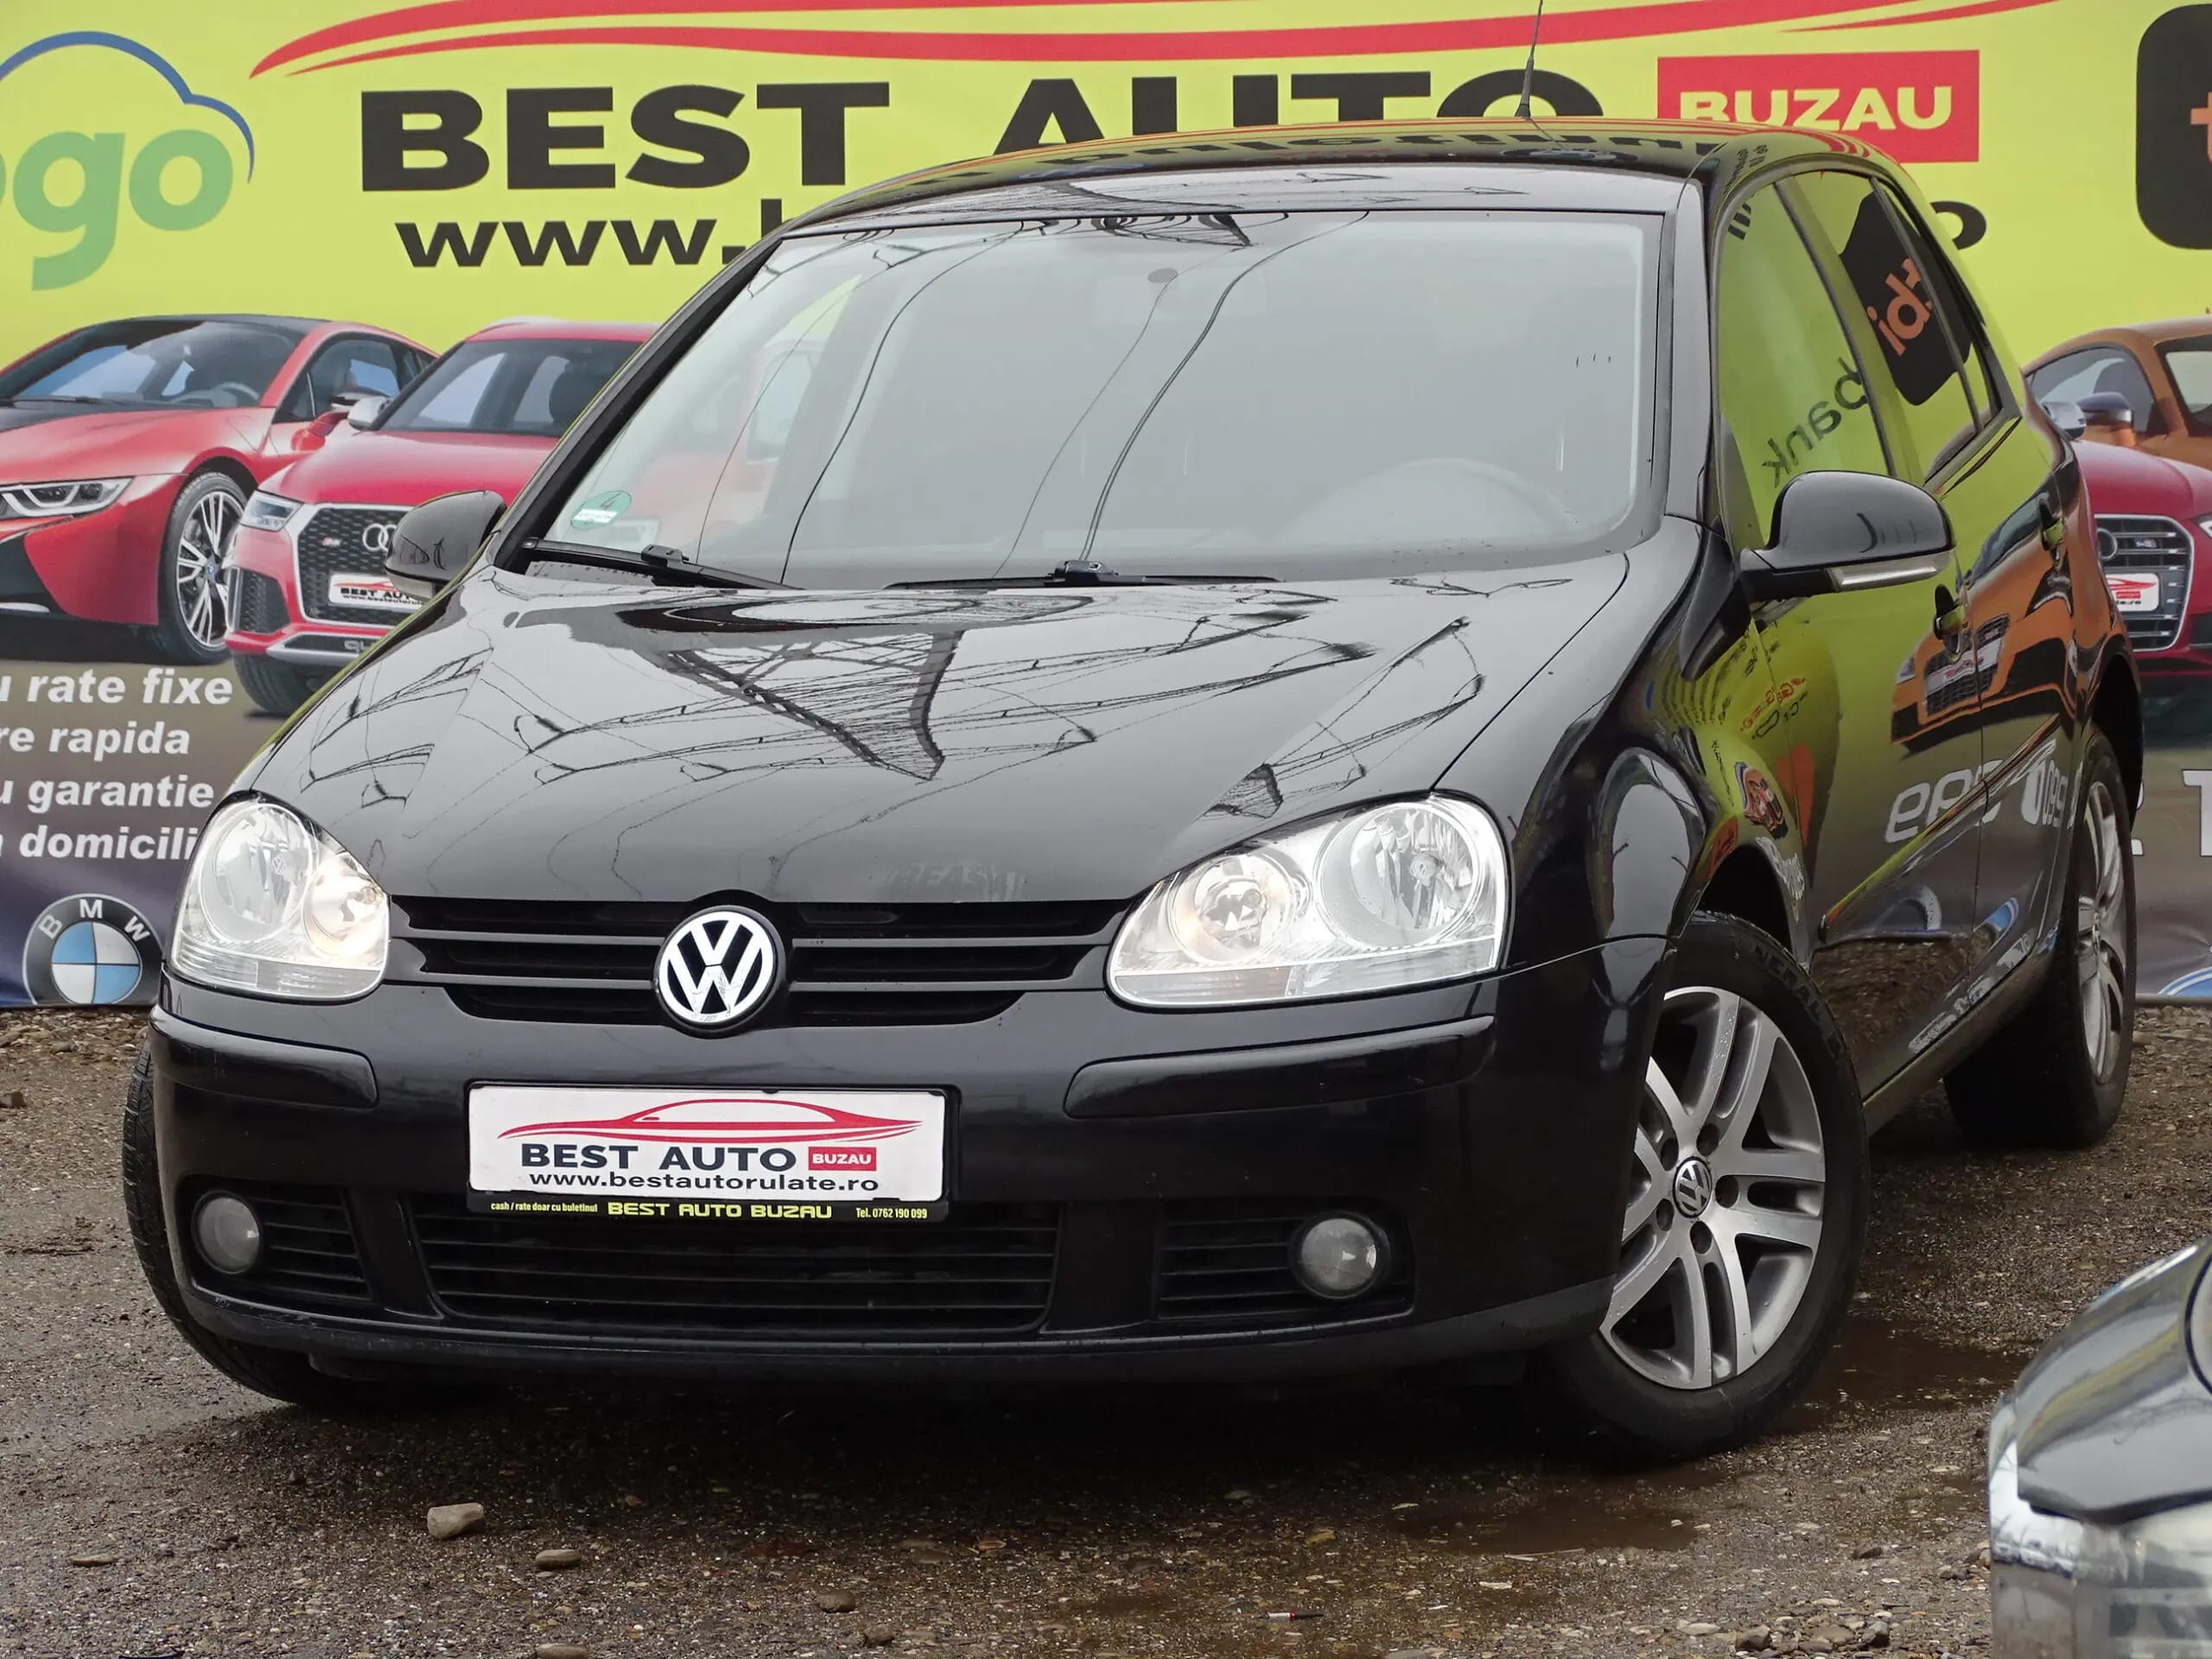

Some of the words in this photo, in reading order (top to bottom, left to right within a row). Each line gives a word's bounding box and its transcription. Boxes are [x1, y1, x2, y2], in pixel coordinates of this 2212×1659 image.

[1681, 86, 1952, 130] BUZAU
[362, 83, 890, 192] BEST
[0, 130, 233, 290] go
[28, 669, 125, 703] rate
[143, 667, 232, 704] fixe
[49, 721, 190, 762] rapida
[27, 774, 214, 814] garantie
[521, 1143, 639, 1169] BEST
[658, 1147, 797, 1172] AUTO
[812, 1154, 872, 1165] BUZAU
[530, 1172, 879, 1192] www.bestautorulate.ro
[491, 1202, 510, 1211] cash
[515, 1202, 531, 1211] rate
[532, 1202, 550, 1211] doar
[562, 1203, 598, 1212] buletinul
[607, 1202, 671, 1216] BEST
[678, 1204, 742, 1217] AUTO
[750, 1205, 832, 1219] BUZAU
[855, 1207, 871, 1218] Tel.
[873, 1208, 893, 1218] 0762
[895, 1208, 910, 1218] 190
[911, 1208, 928, 1219] 099
